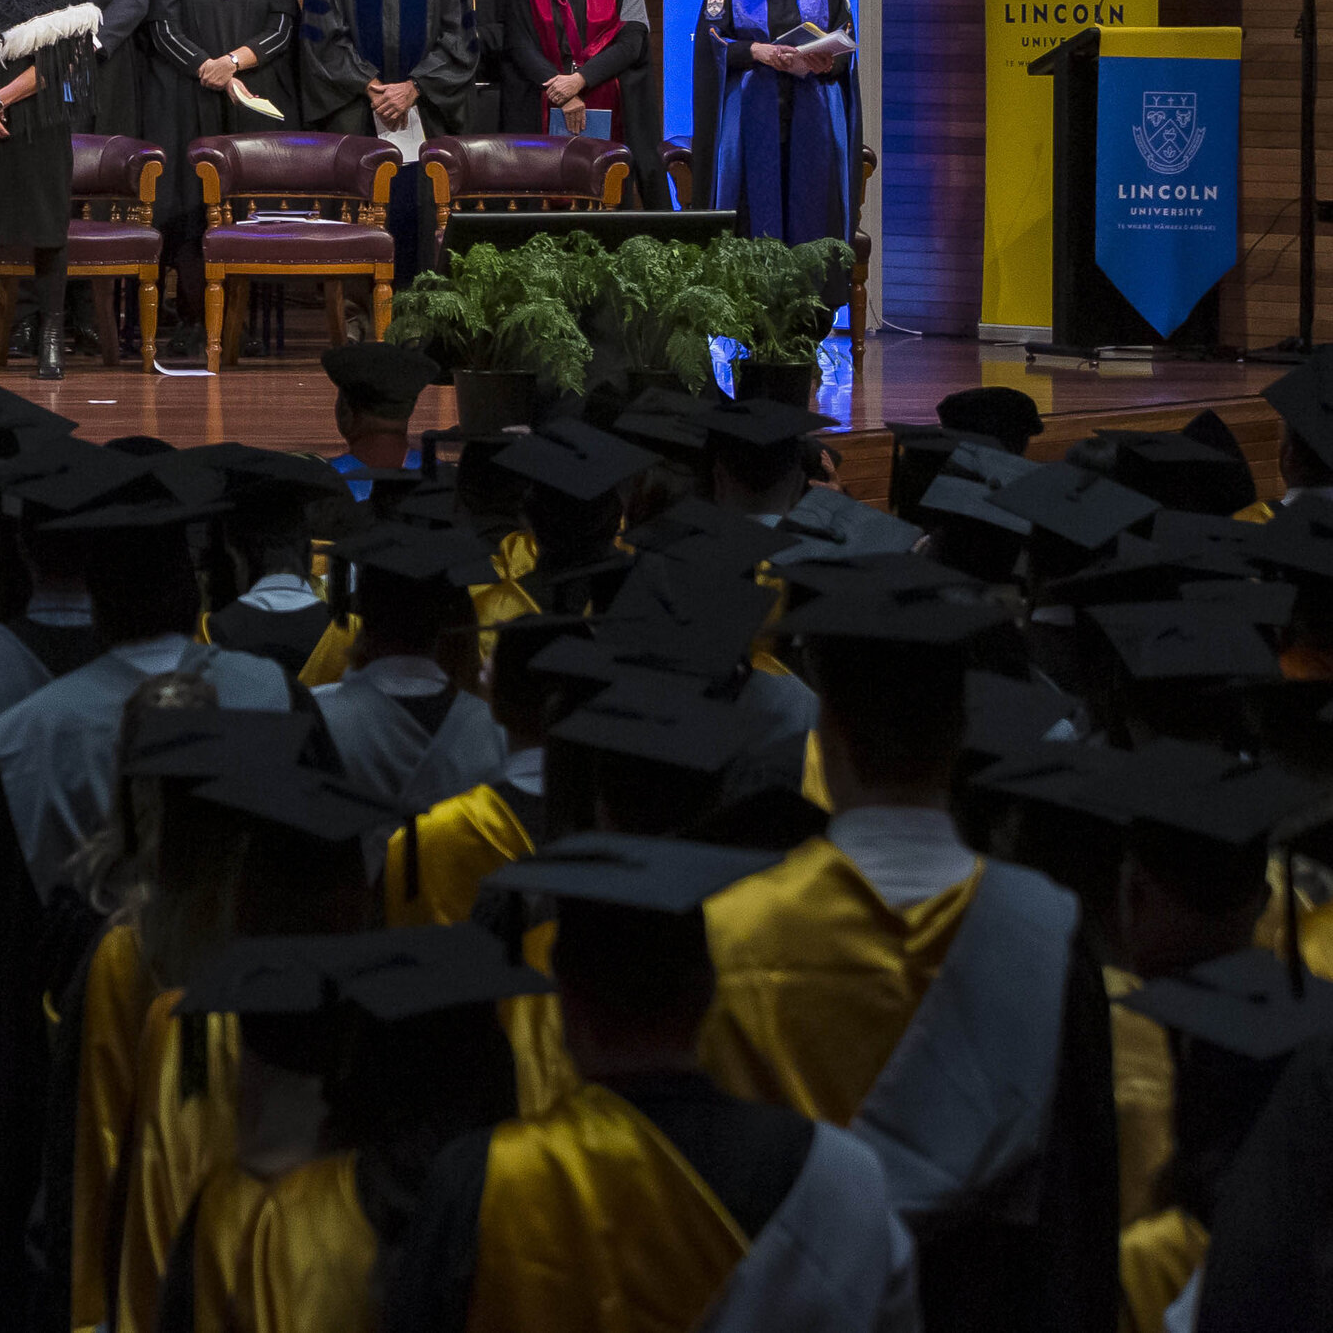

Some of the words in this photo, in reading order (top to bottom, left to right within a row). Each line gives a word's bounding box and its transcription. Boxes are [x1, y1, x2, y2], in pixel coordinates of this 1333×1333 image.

[1005, 3, 1124, 24] LINCOLN
[1118, 184, 1218, 200] LINCOLN
[1130, 207, 1204, 217] UNIVERSITY
